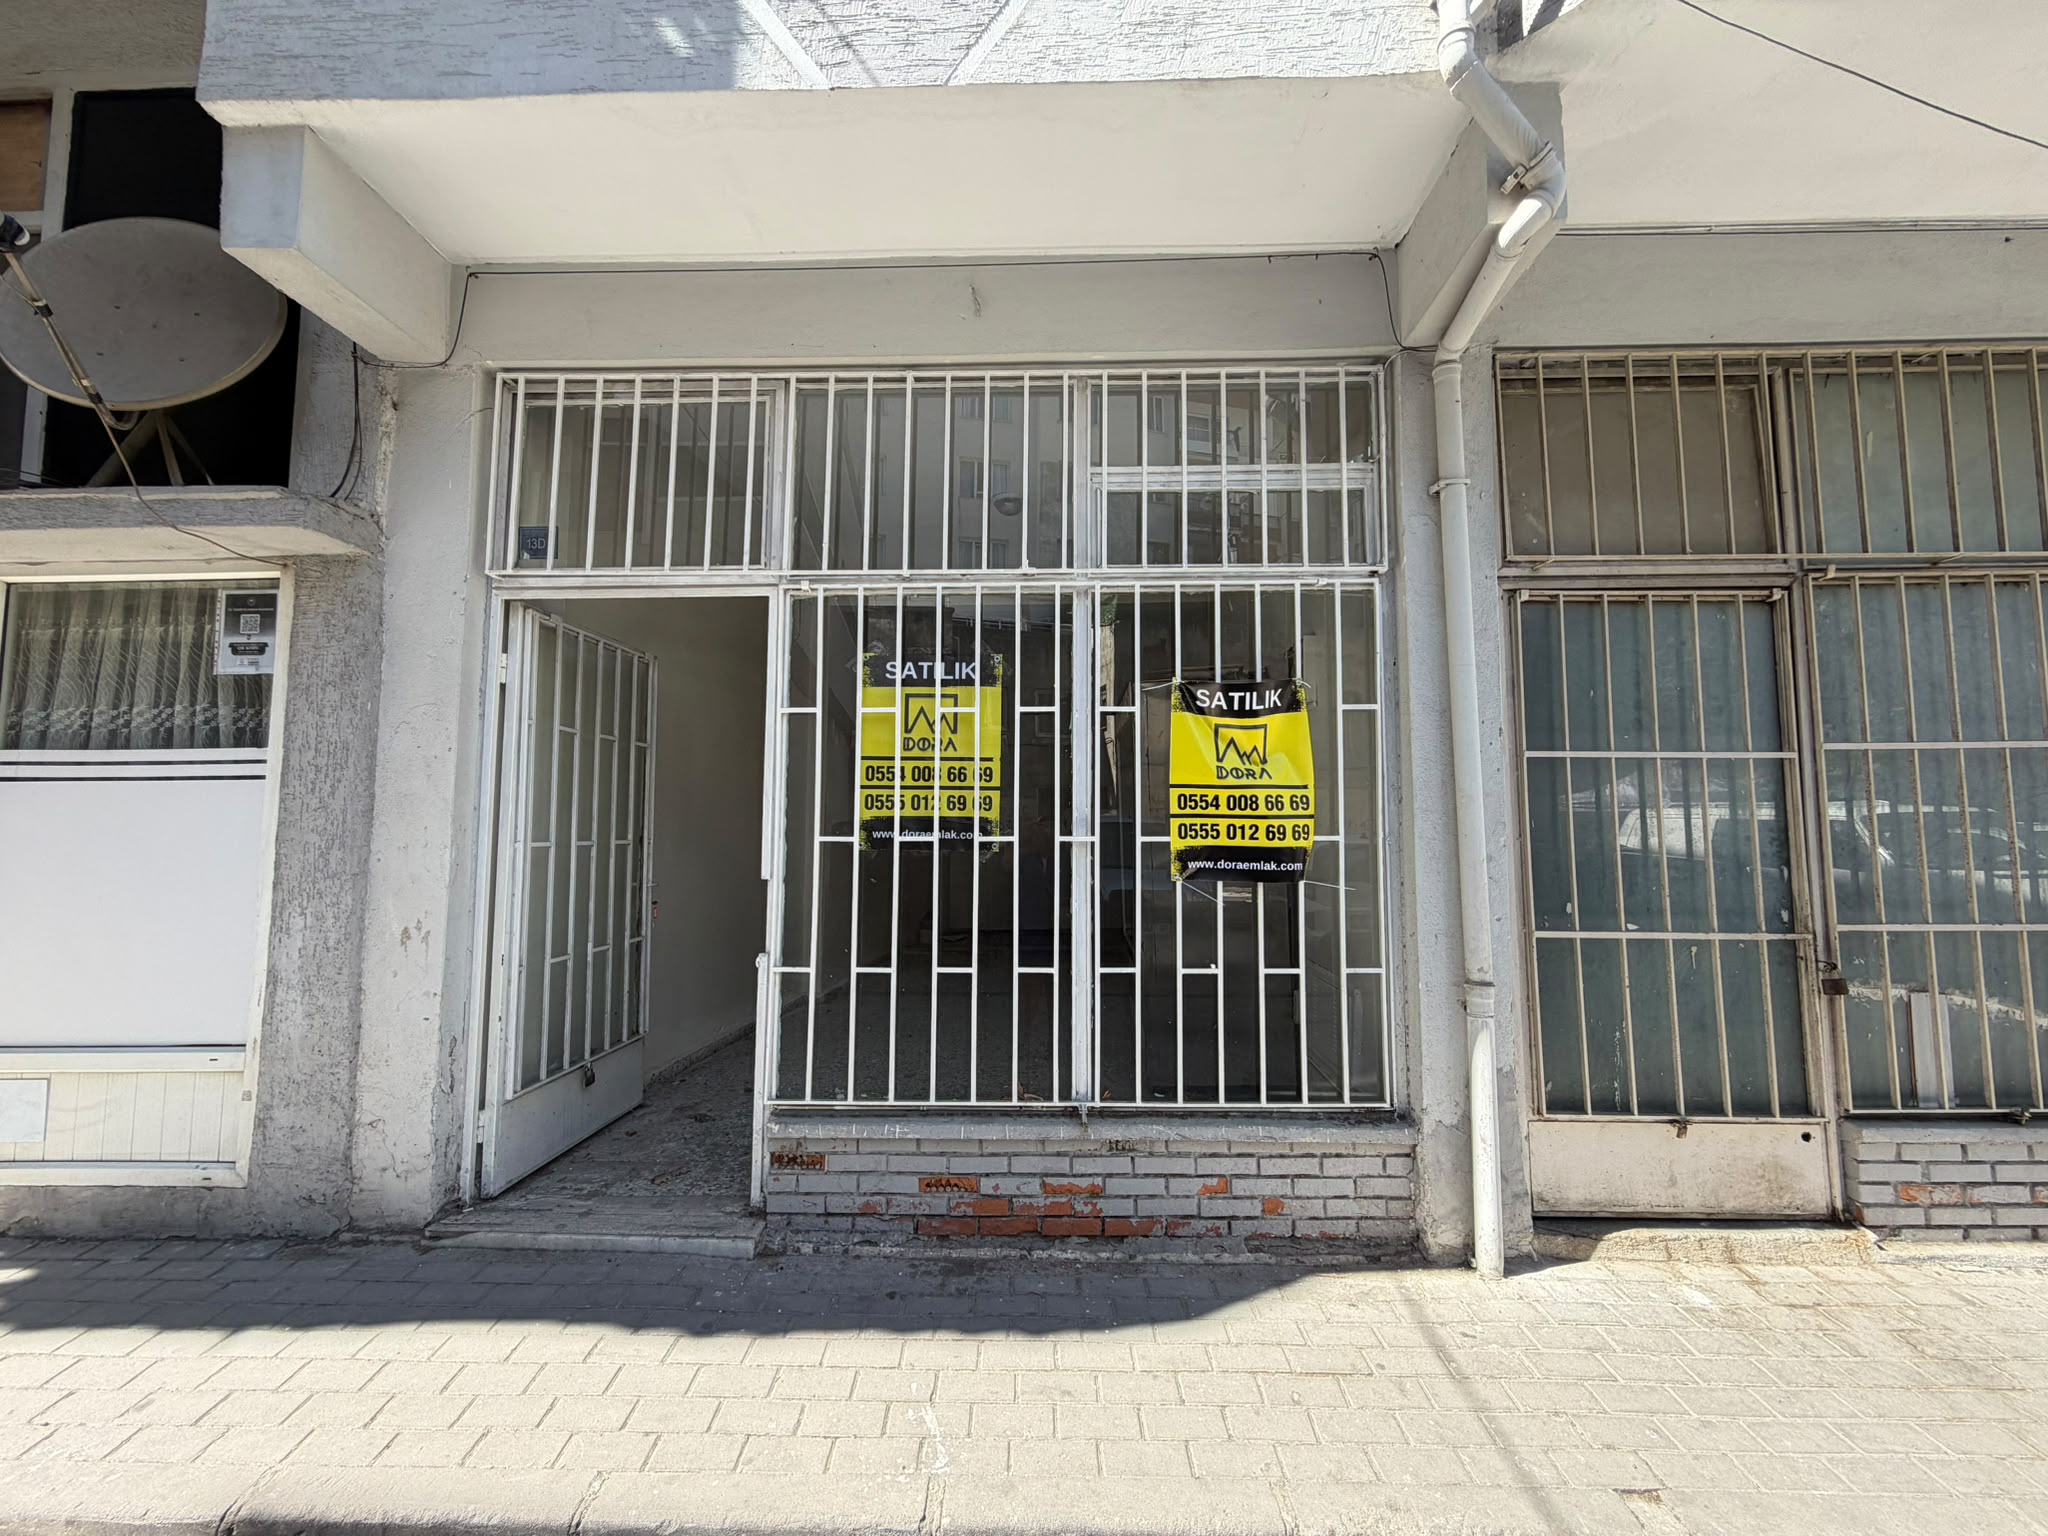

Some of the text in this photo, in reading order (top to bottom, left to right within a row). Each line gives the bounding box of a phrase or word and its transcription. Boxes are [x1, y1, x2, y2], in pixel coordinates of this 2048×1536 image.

[527, 538, 546, 549] 13D
[885, 661, 978, 680] SATILIK
[1195, 688, 1283, 711] SATILIK
[903, 736, 958, 752] DORA
[865, 765, 906, 782] 0554
[947, 766, 968, 783] 66
[1216, 765, 1273, 780] DORA
[864, 794, 906, 811] 0555
[946, 795, 967, 812] 69
[1177, 793, 1310, 812] 0554 008 66 69
[872, 829, 983, 840] wwwdoraelak.co
[1177, 823, 1310, 841] 0555 012 69 69
[1187, 859, 1304, 871] www.doraemlak.com
